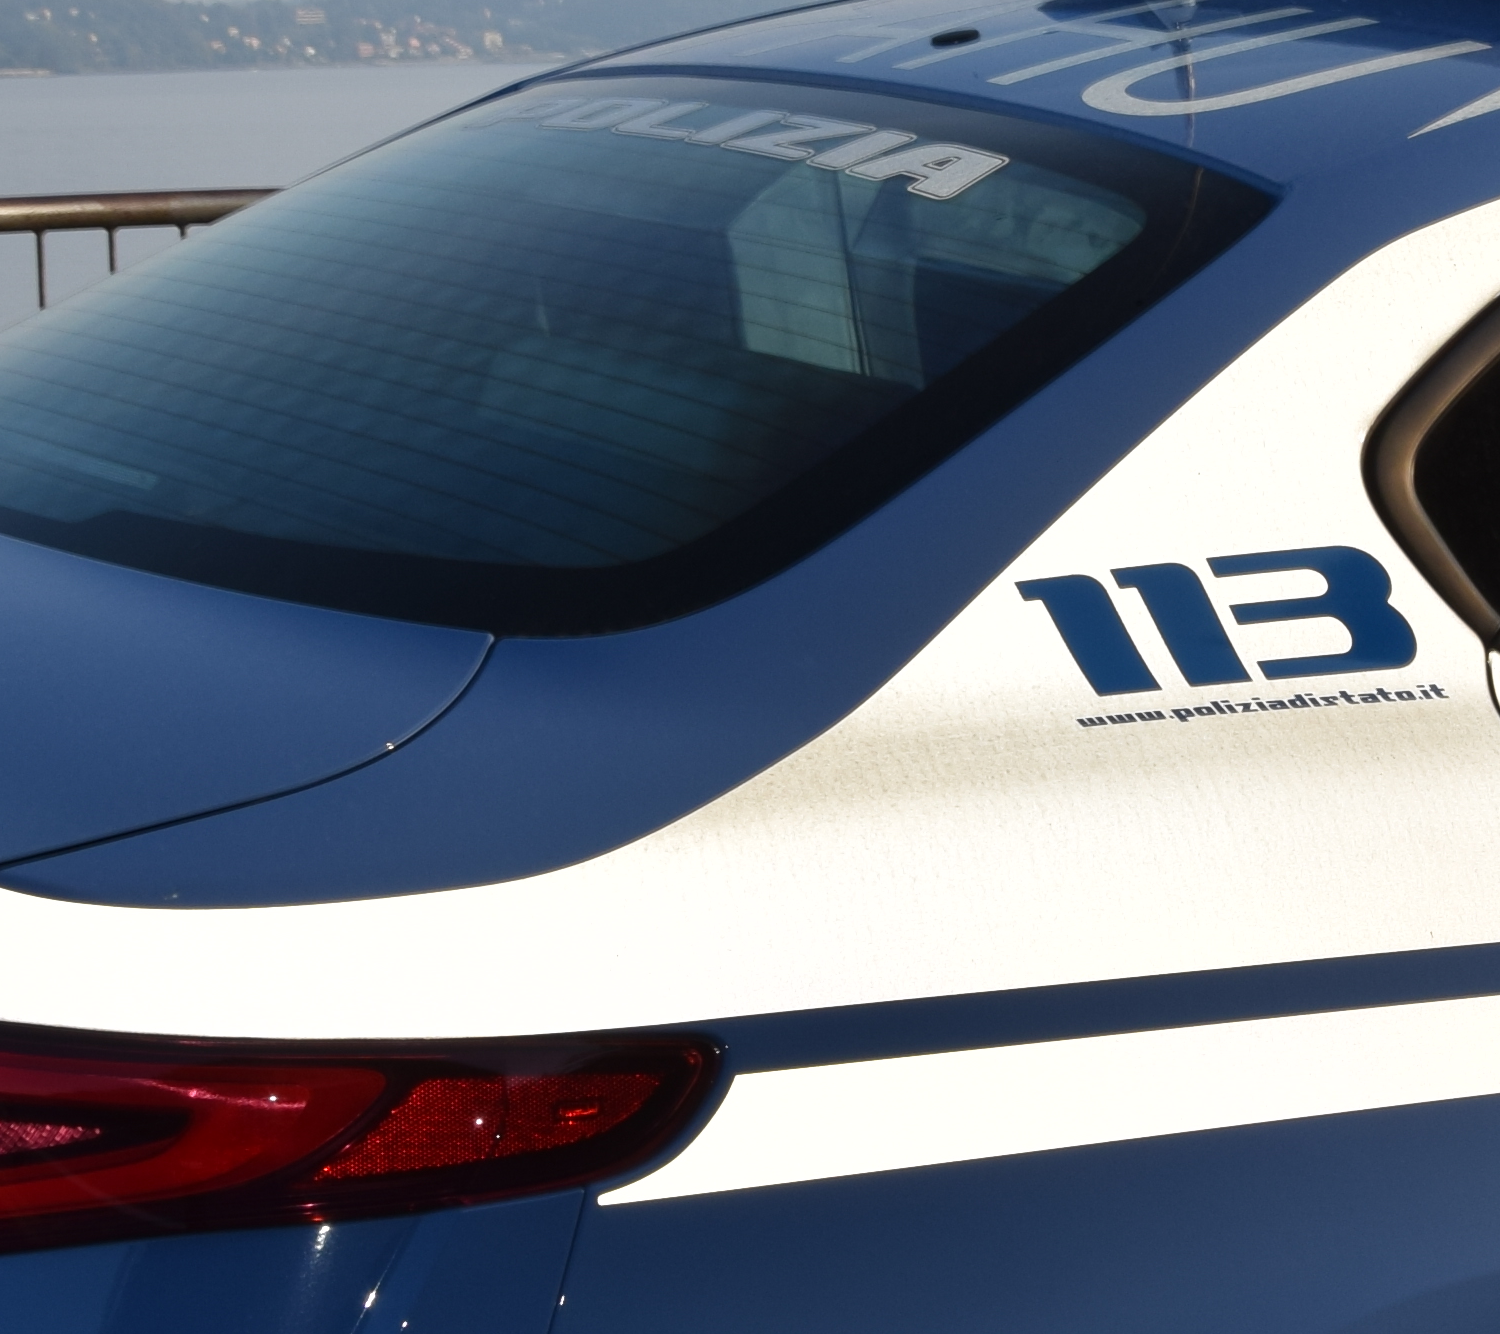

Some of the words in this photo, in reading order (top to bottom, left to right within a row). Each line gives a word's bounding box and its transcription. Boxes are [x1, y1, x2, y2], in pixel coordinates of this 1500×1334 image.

[463, 97, 1009, 201] POLIZIA
[1014, 545, 1417, 697] 113
[1076, 683, 1449, 729] www.poliziadistato.it
